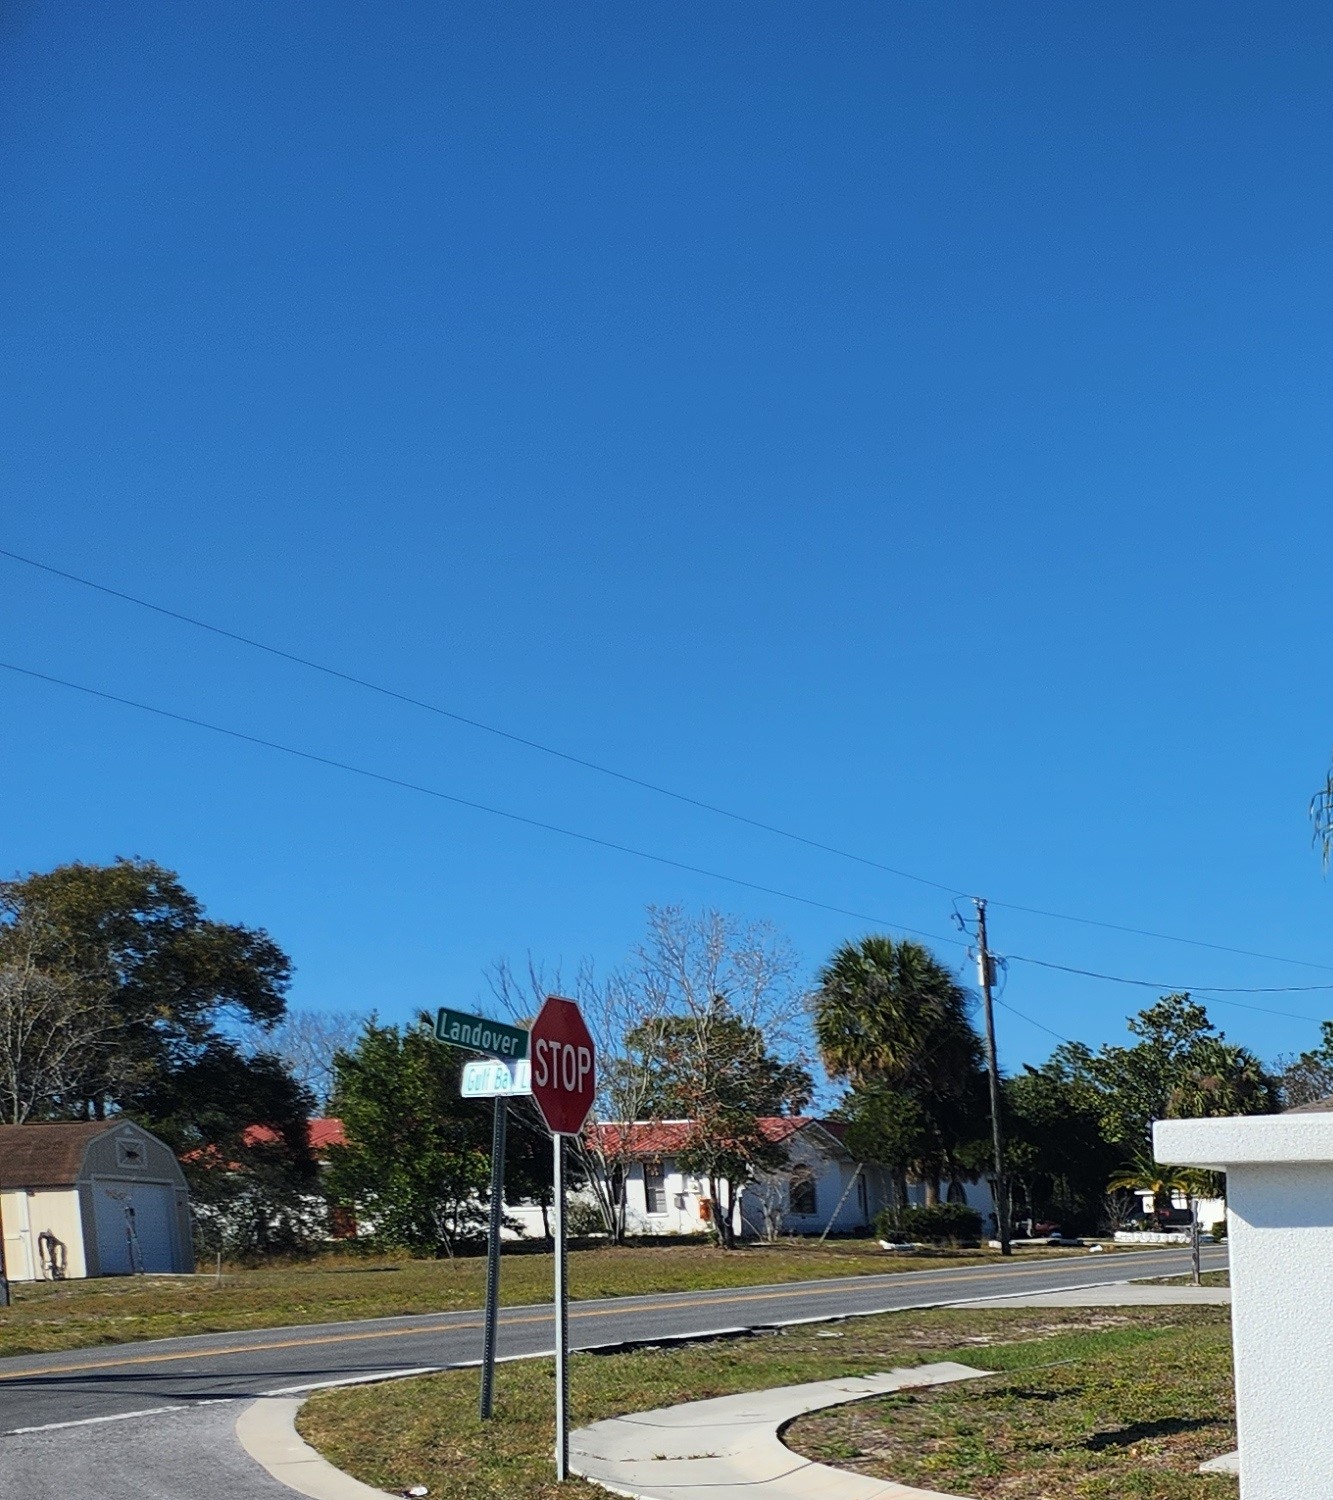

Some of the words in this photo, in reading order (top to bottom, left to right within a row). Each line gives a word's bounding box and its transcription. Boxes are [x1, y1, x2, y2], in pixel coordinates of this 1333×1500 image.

[440, 1012, 519, 1056] Landover
[467, 1066, 491, 1092] Gulf
[494, 1066, 512, 1091] Ba
[535, 1038, 591, 1093] STOP
